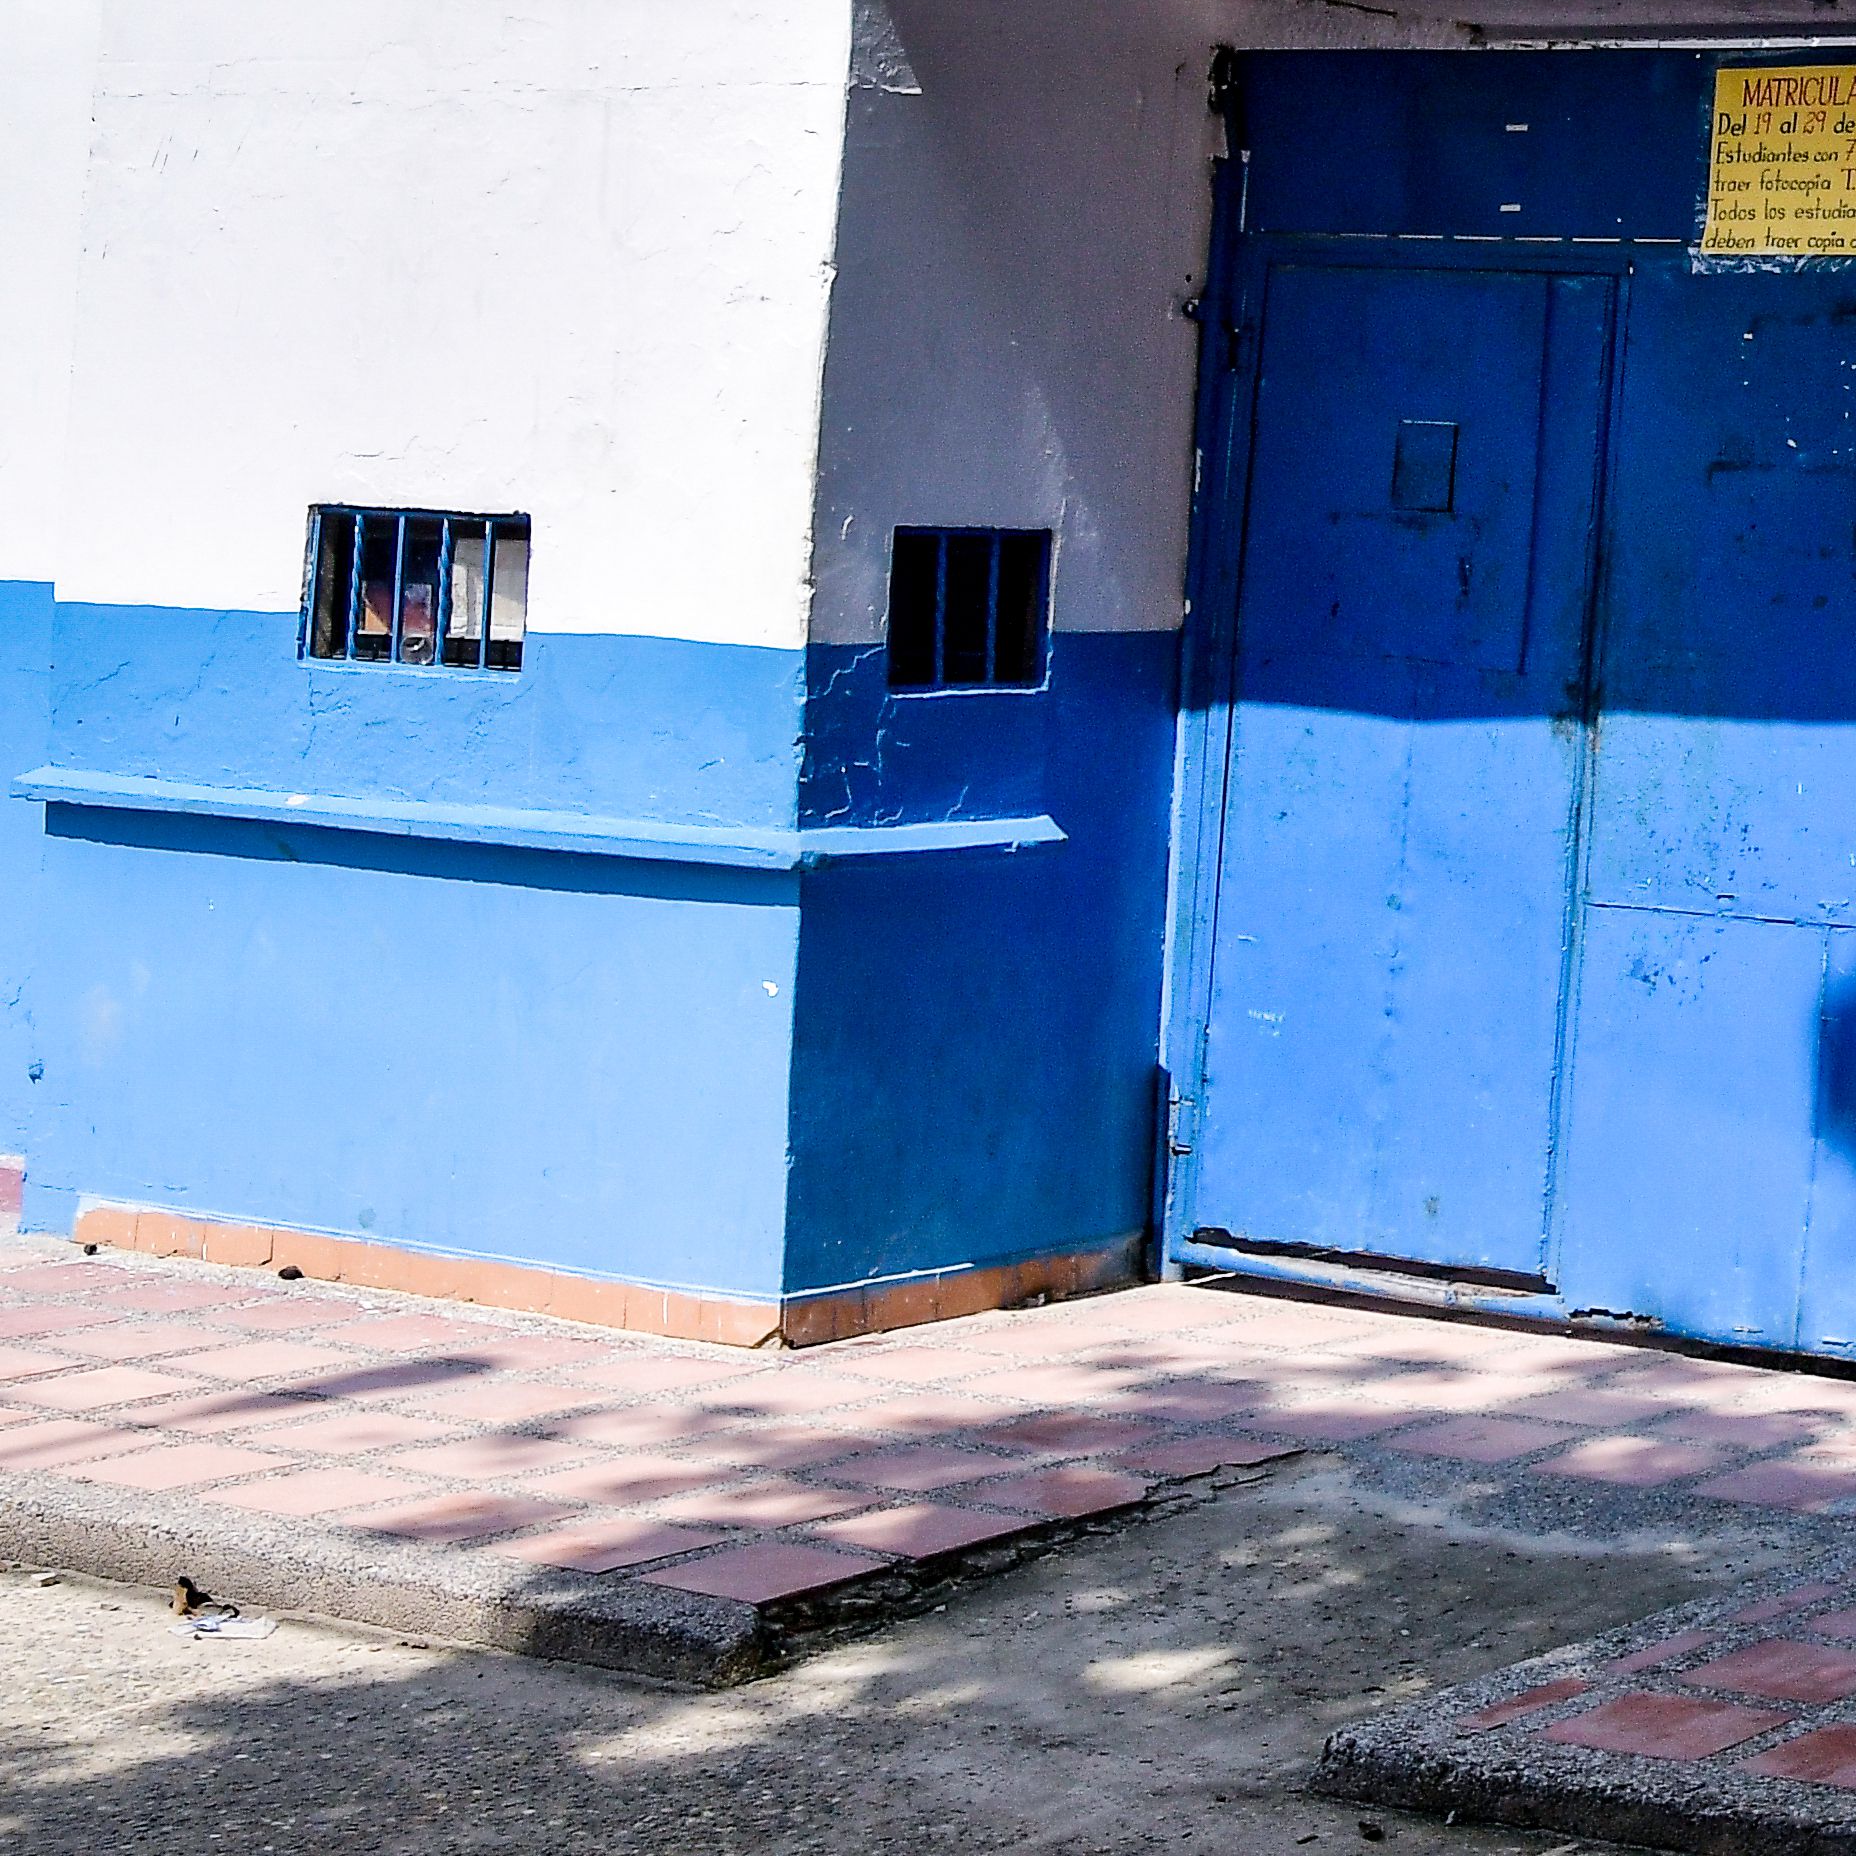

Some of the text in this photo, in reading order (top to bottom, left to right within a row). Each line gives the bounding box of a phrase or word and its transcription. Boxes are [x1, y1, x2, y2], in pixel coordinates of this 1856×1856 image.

[1717, 112, 1747, 136] Del
[1753, 111, 1772, 134] 19
[1779, 111, 1798, 134] al
[1803, 110, 1826, 134] 29
[1833, 113, 1855, 134] de
[1716, 140, 1810, 164] Estudiantes
[1813, 150, 1839, 163] con
[1713, 168, 1752, 192] traer
[1760, 168, 1832, 197] fotocopia
[1711, 198, 1757, 221] Todos
[1764, 197, 1786, 221] los
[1705, 227, 1756, 249] deben
[1764, 226, 1803, 249] traer
[1807, 231, 1845, 252] copia
